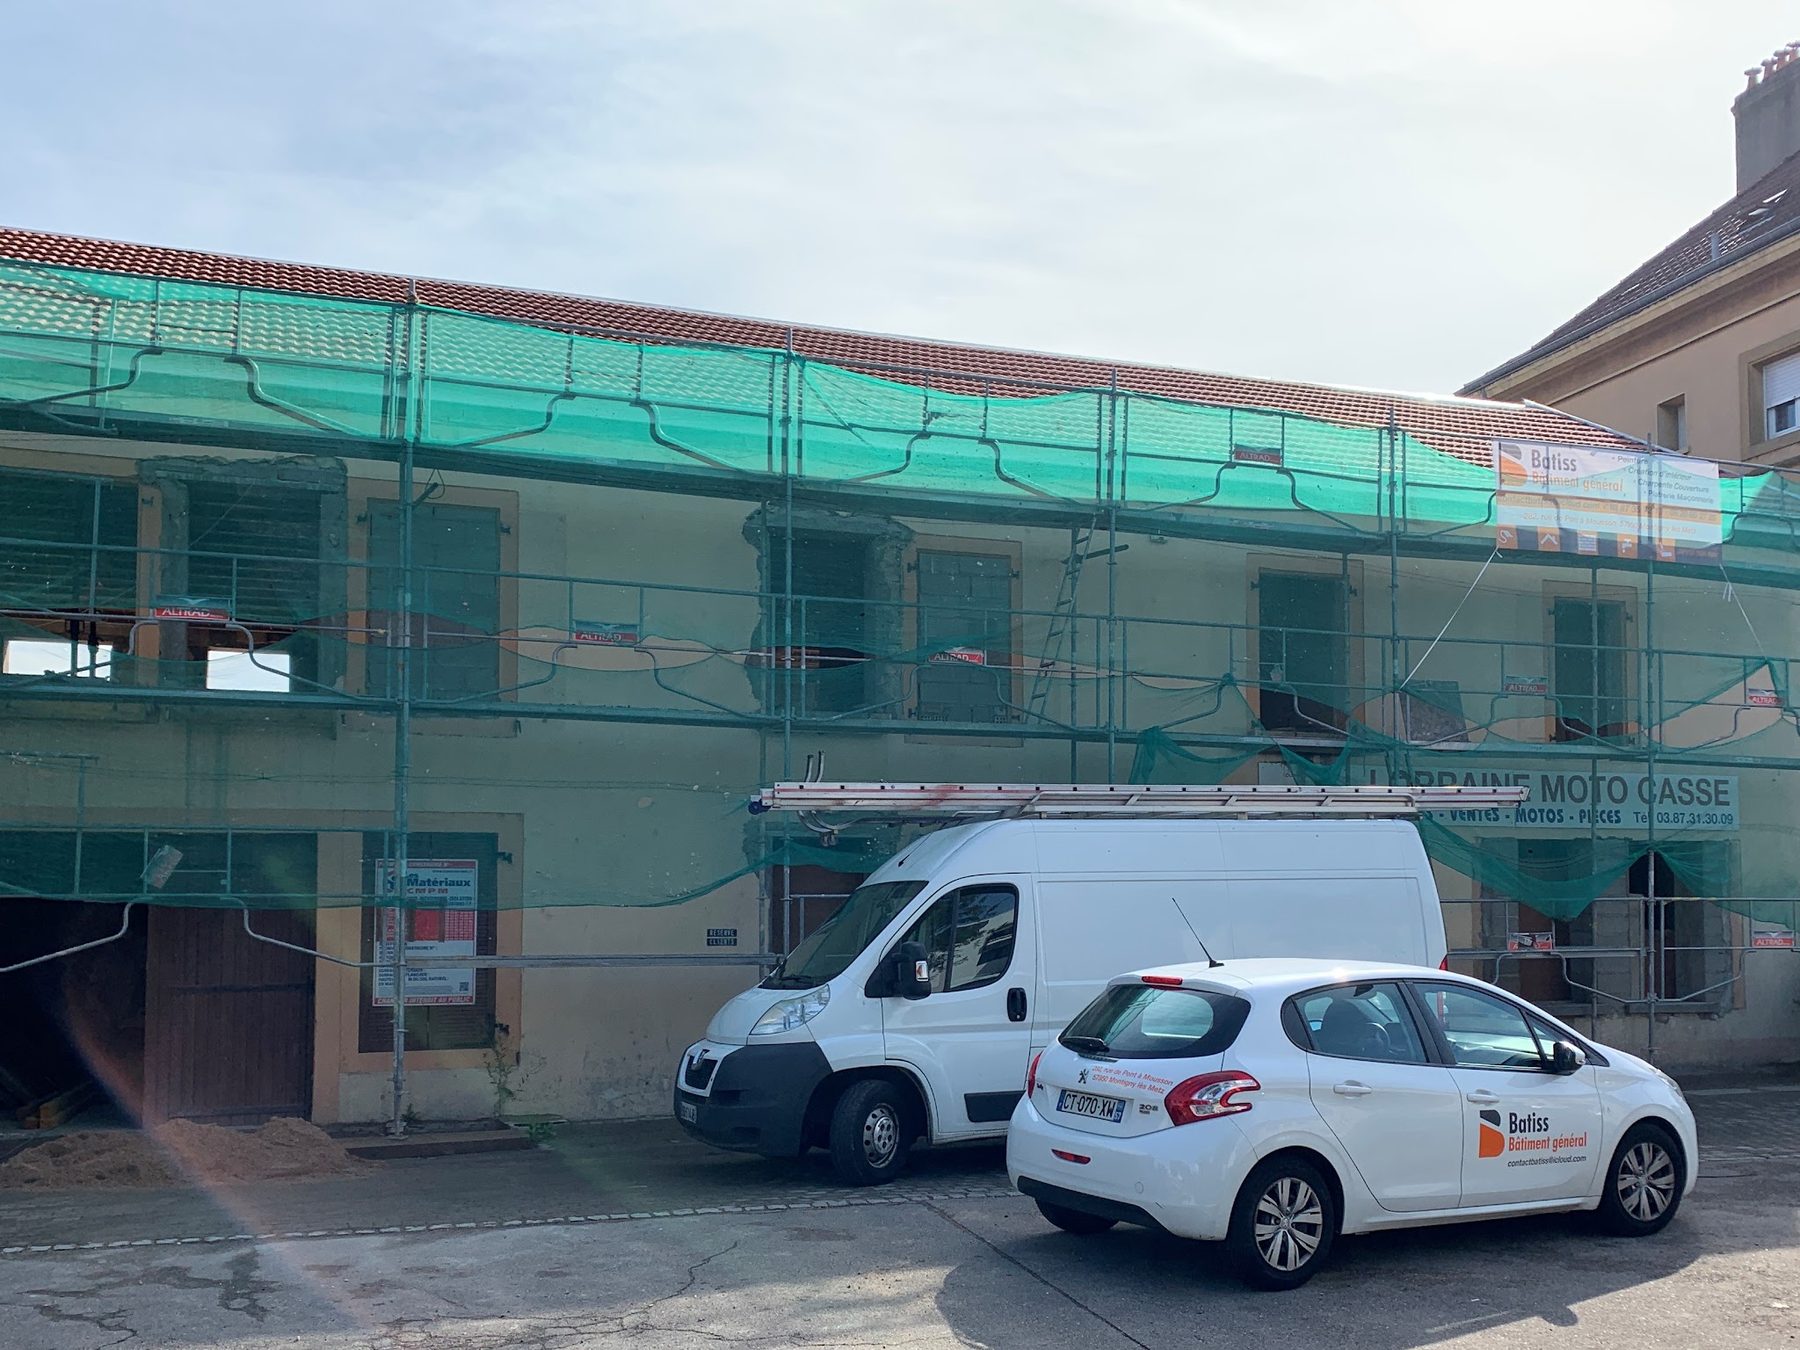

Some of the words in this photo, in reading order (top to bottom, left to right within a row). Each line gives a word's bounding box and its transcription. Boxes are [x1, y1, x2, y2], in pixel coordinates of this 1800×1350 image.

[1239, 451, 1270, 462] ALTRAD
[1531, 449, 1577, 472] Batiss
[162, 607, 210, 617] ALTRAD
[1540, 774, 1628, 805] MOTO
[1637, 776, 1730, 806] CASSE
[1450, 807, 1500, 822] VENTES
[1515, 808, 1564, 823] MOTOS
[1656, 811, 1734, 825] 03.87.31.30.09
[406, 877, 471, 887] Matériaux
[1147, 1084, 1166, 1094] Metz
[1509, 1112, 1549, 1134] Batiss
[1508, 1135, 1550, 1152] Bâtiment
[1552, 1132, 1587, 1152] général
